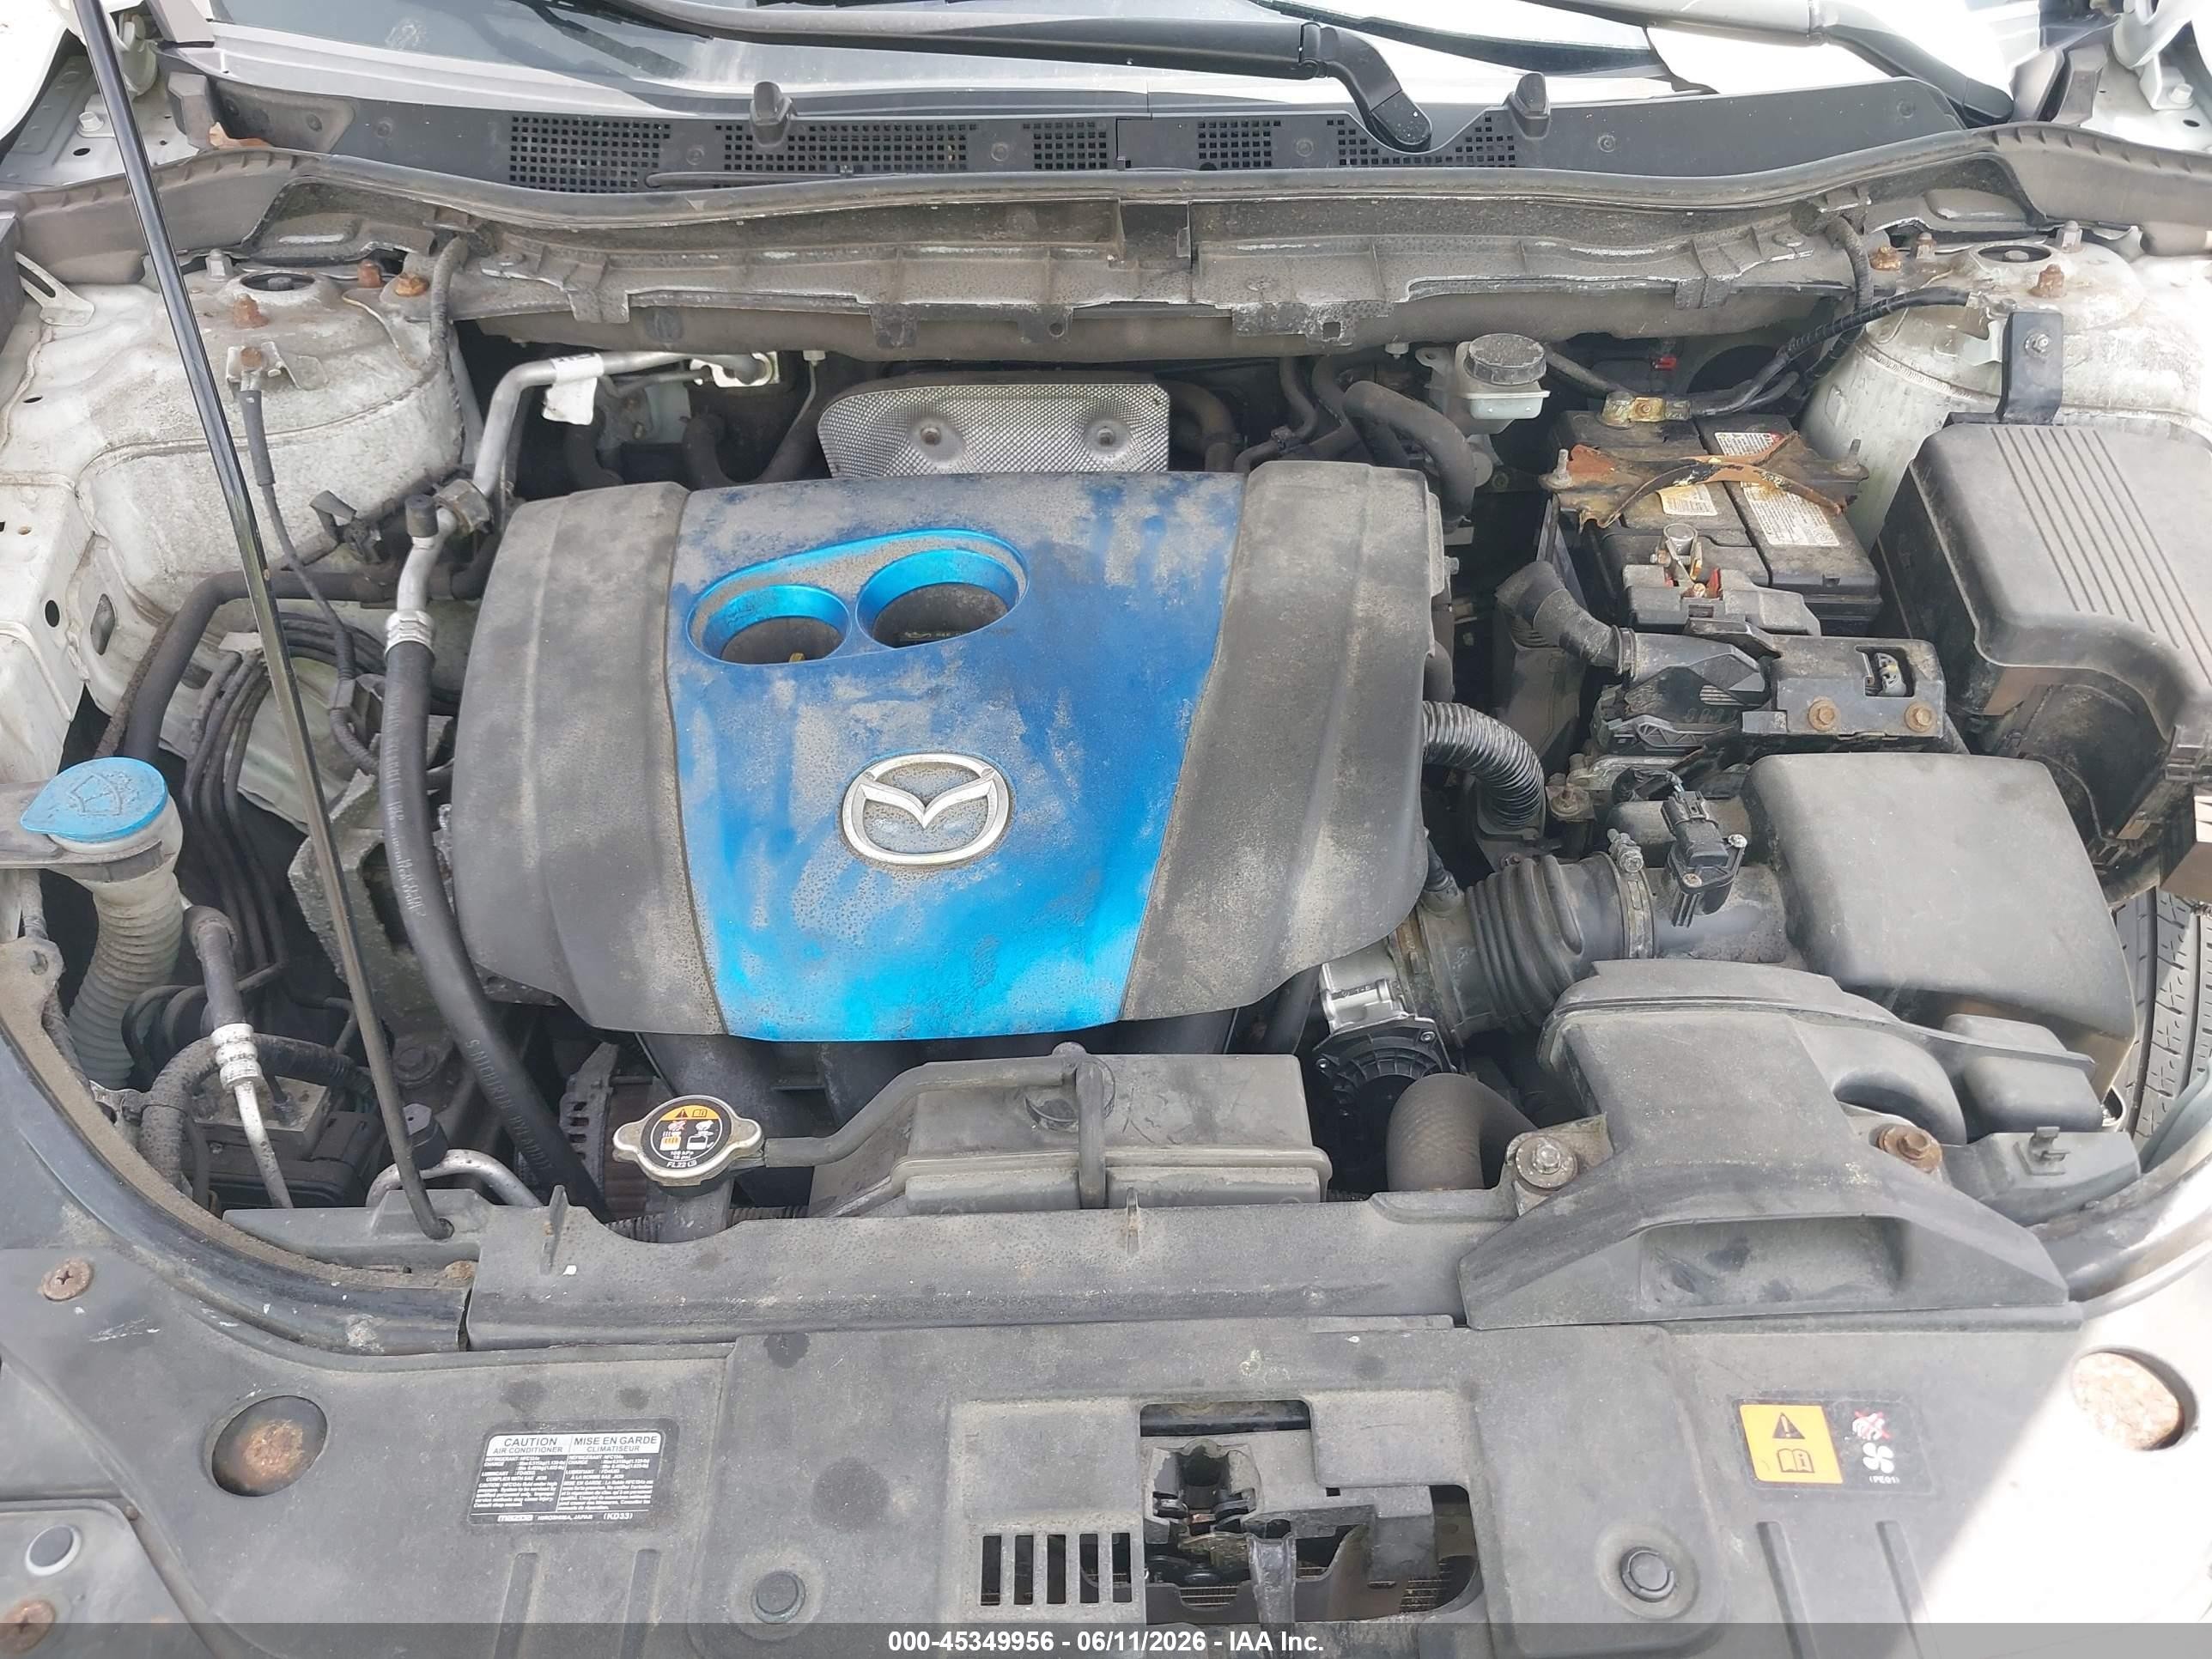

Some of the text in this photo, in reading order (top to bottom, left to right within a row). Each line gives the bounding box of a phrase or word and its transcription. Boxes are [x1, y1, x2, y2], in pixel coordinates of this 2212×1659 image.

[504, 1437, 558, 1447] CAUTION
[574, 1437, 600, 1445] MISE
[619, 1436, 658, 1444] GARDE
[497, 1514, 533, 1522] mazda
